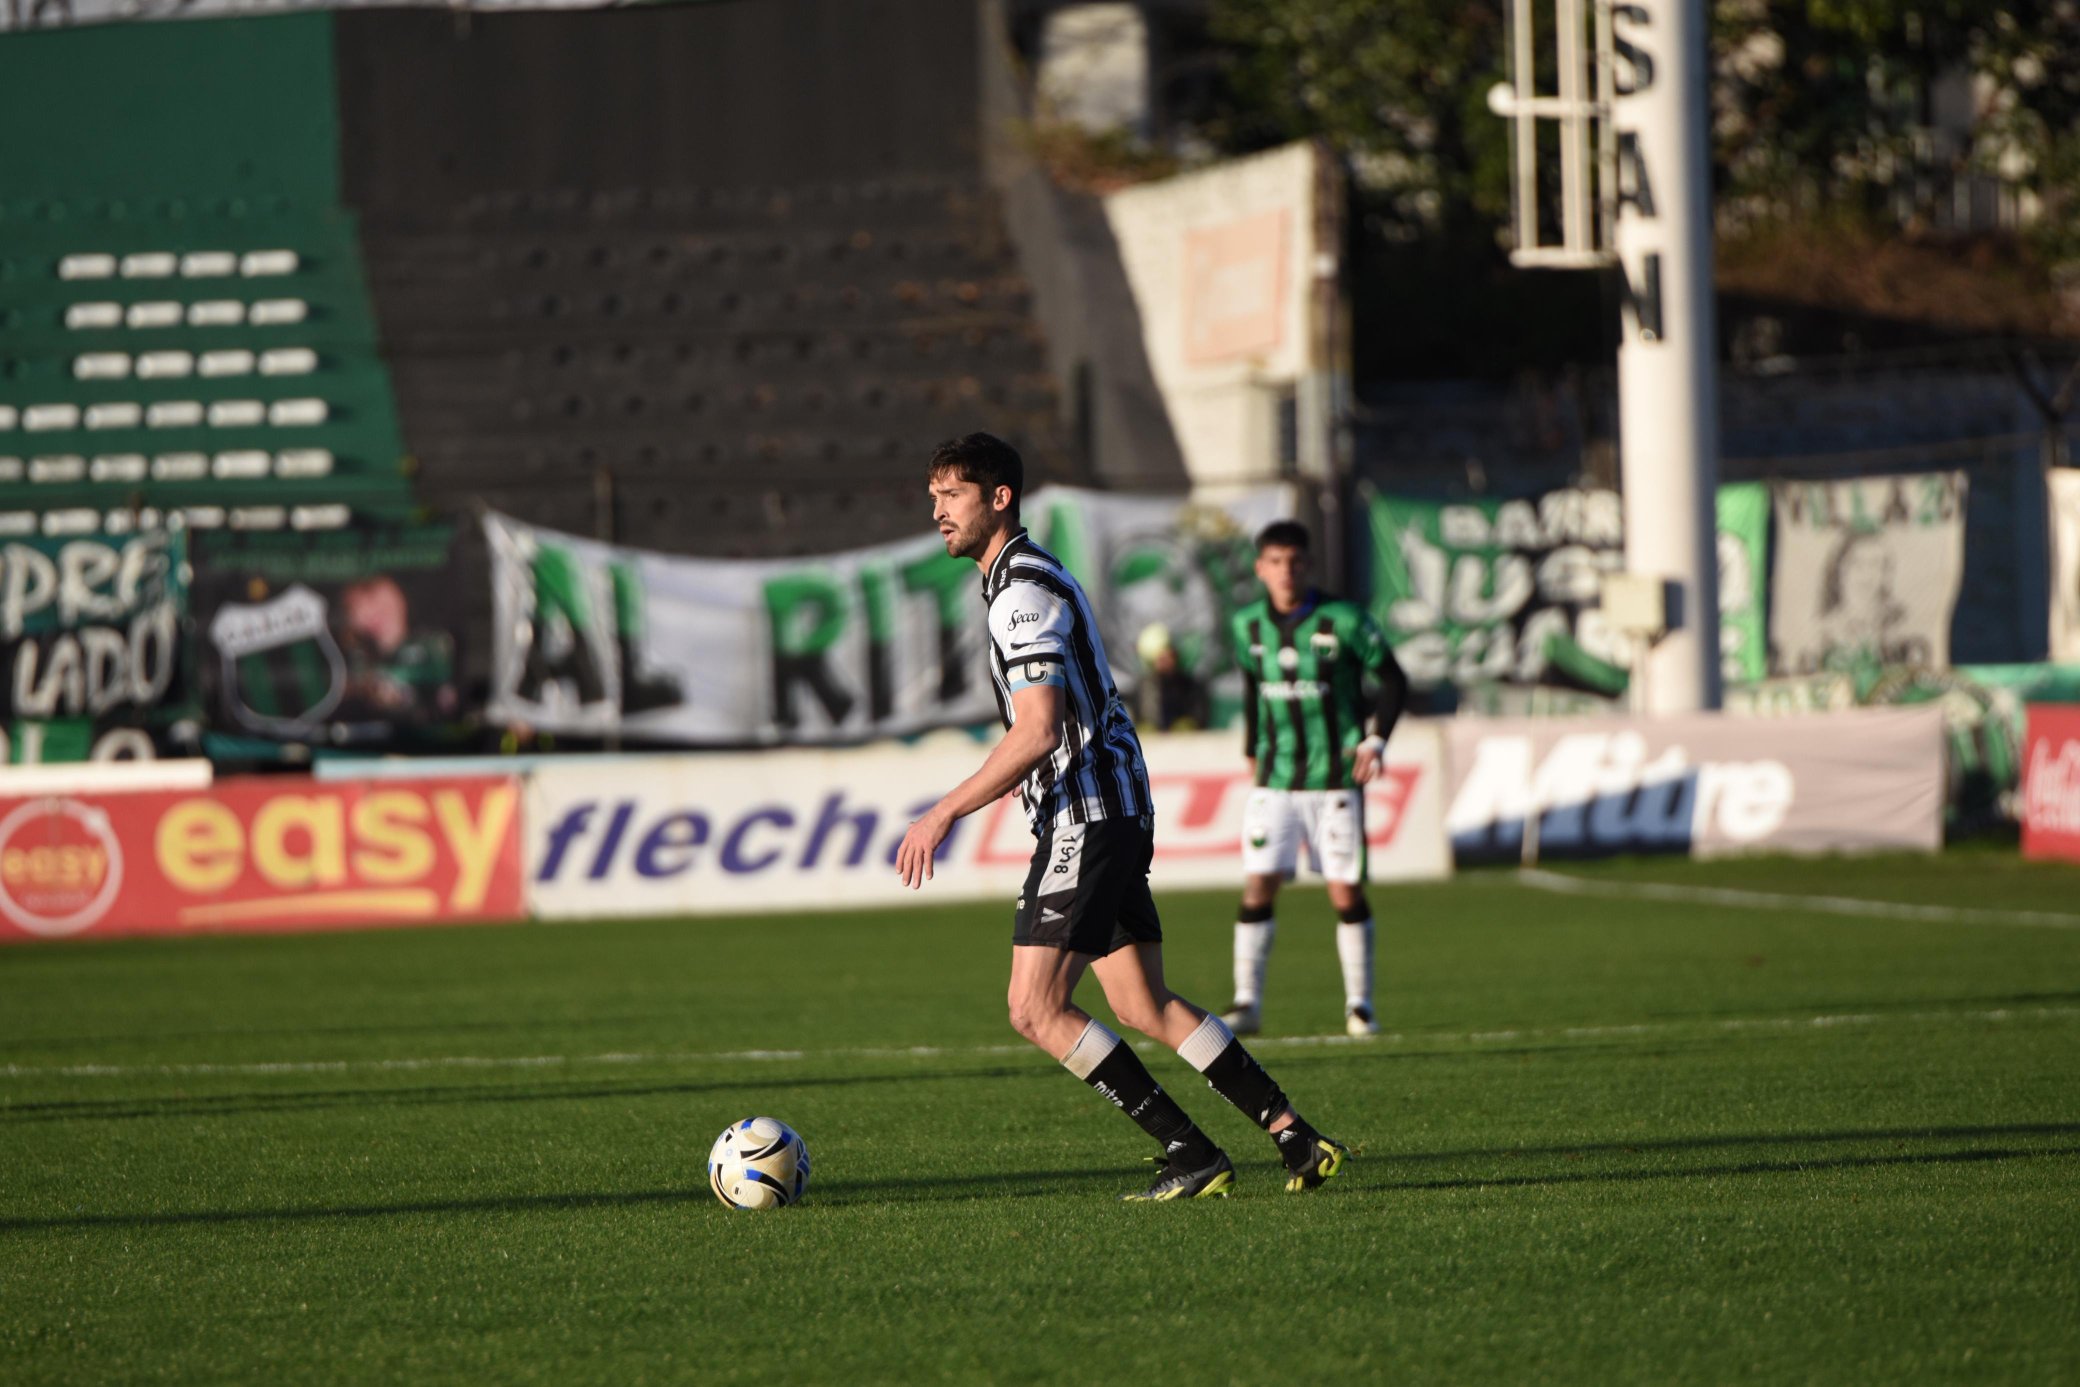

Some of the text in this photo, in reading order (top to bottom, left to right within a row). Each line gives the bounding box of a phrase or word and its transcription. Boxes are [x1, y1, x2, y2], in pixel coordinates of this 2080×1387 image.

[13, 601, 176, 717] LADO
[513, 541, 687, 718] AL
[1008, 609, 1039, 631] Secco
[537, 788, 966, 883] flecha
[1447, 730, 1794, 842] Mitre
[155, 783, 516, 912] easy
